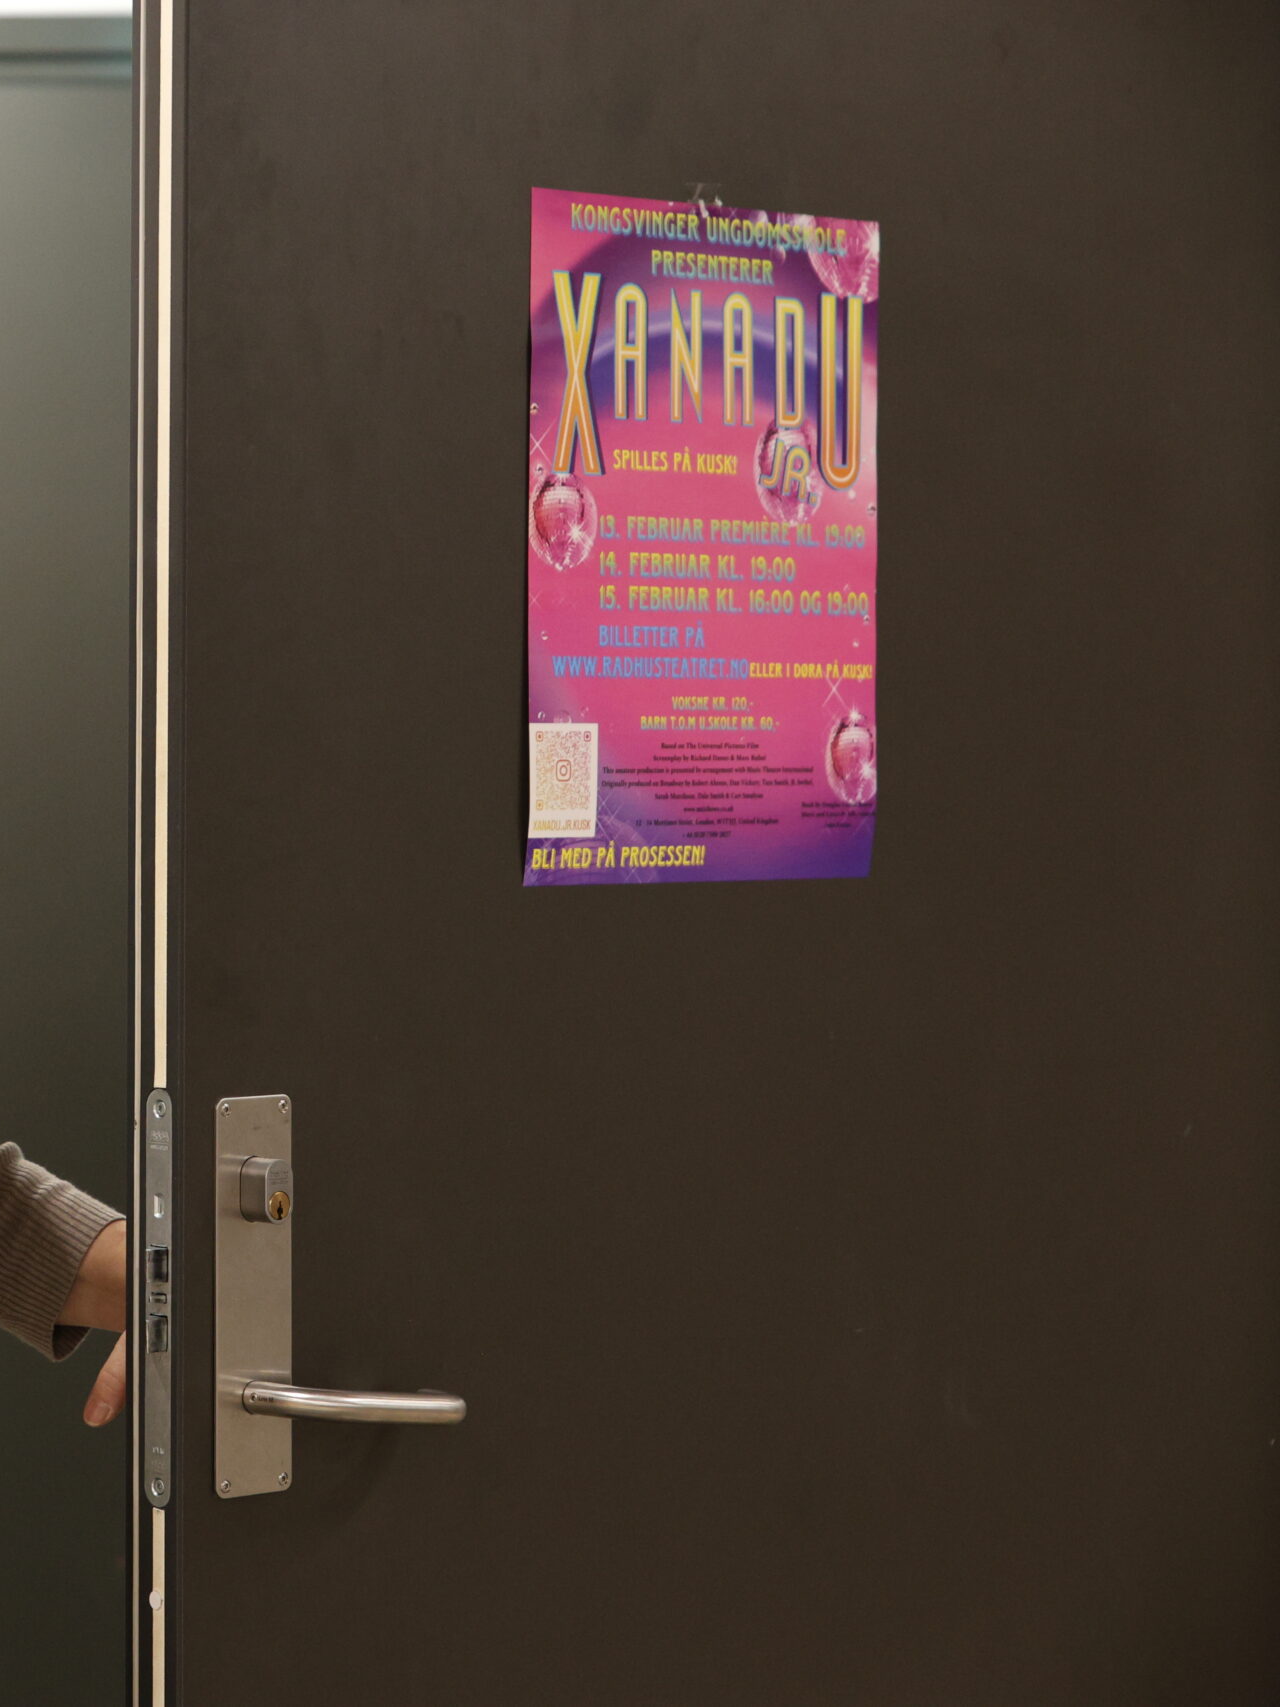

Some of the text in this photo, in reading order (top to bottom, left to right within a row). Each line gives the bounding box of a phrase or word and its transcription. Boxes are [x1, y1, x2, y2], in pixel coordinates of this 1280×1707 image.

[571, 202, 847, 257] KONGSVINGER UNGDOMSSKOLE
[651, 249, 774, 286] PRESENTERER
[552, 270, 863, 490] XANADU
[613, 446, 738, 475] SPILLES PÅ KUSK!
[759, 438, 818, 507] JR.
[599, 515, 621, 539] 13.
[627, 516, 704, 543] FEBRUAR
[796, 523, 820, 547] KL.
[825, 524, 865, 548] 19:00
[600, 551, 796, 582] 14. FEBRUAR KL. 19:00
[600, 585, 869, 617] 15. FEBRUAR KL. 16:00 OG 19:00
[599, 619, 705, 648] BILLETTER PÅ
[552, 656, 749, 680] WWW.RADHUSTEATRET.NO
[749, 662, 782, 678] ELLER
[826, 659, 839, 679] PÅ
[671, 696, 709, 711] VOKSNE
[640, 716, 667, 731] BARN
[531, 840, 706, 869] BLI MED PÅ PROSESSEN!
